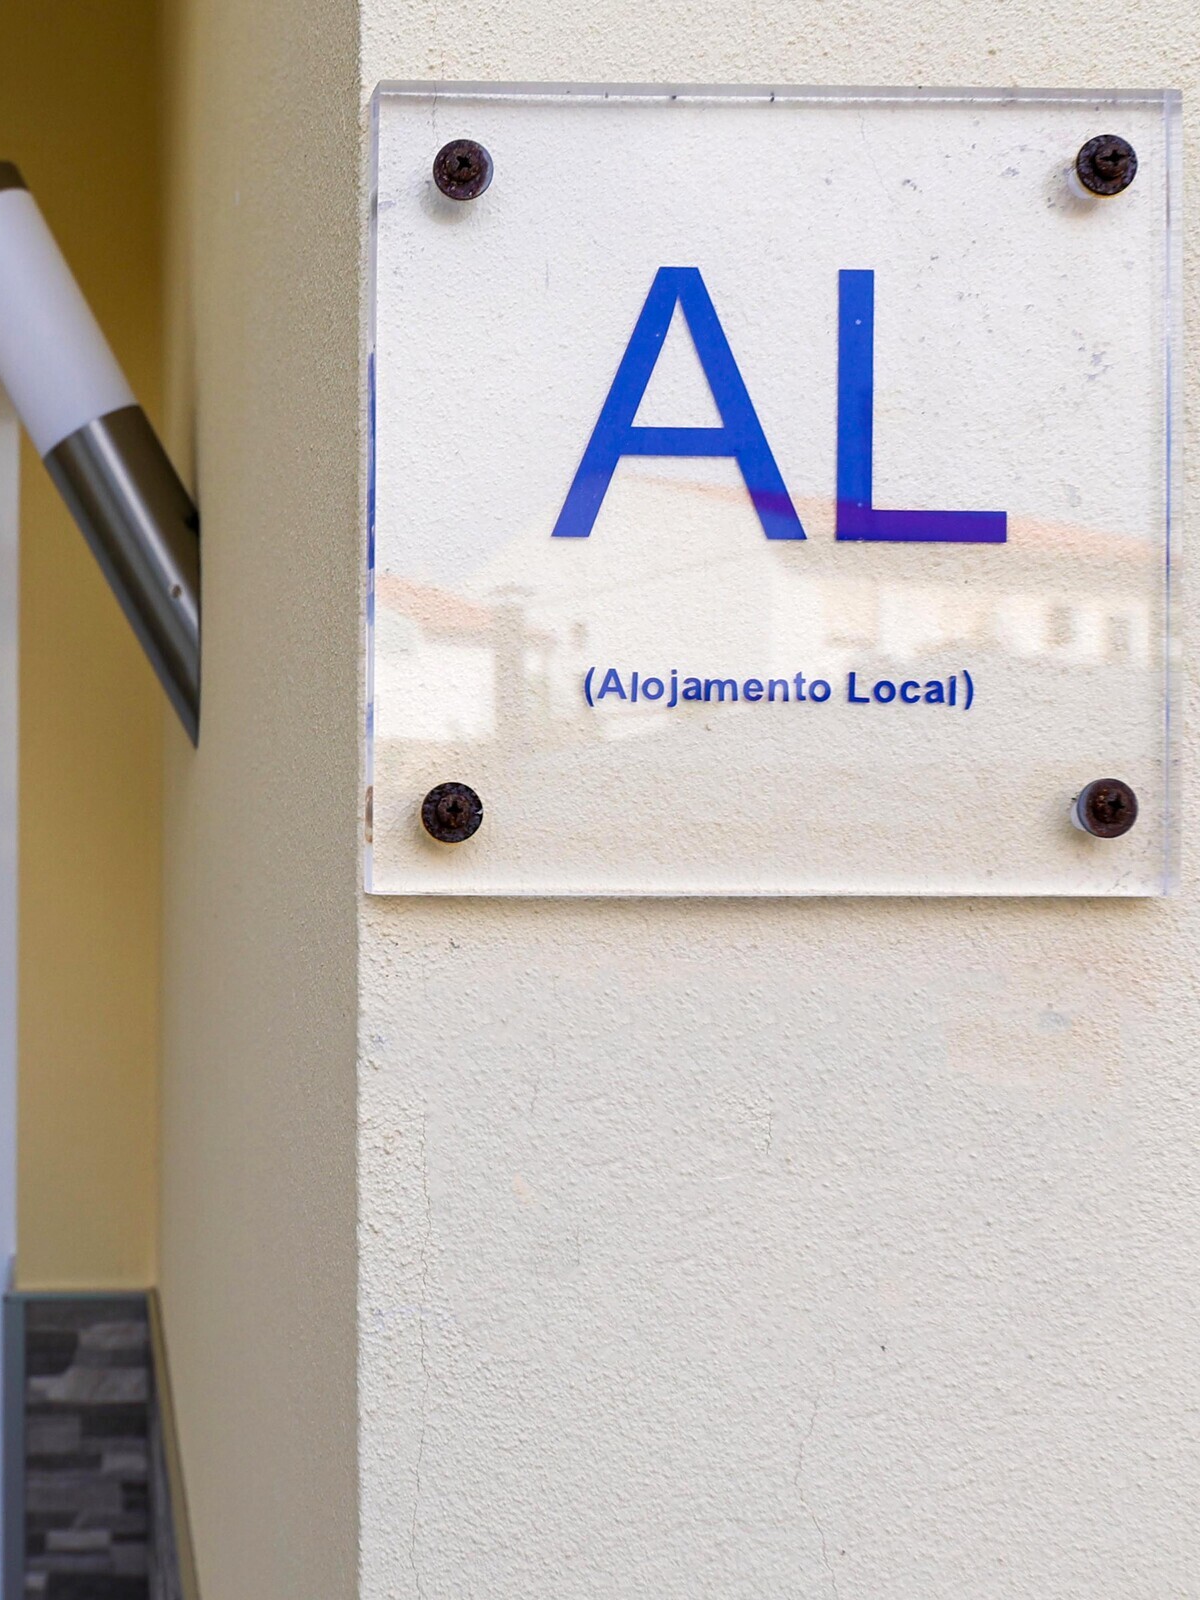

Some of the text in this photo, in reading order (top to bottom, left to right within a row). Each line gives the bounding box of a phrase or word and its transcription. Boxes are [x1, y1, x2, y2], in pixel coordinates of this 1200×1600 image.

[552, 266, 1007, 543] AL
[584, 667, 975, 710] (Alojamento Local)
